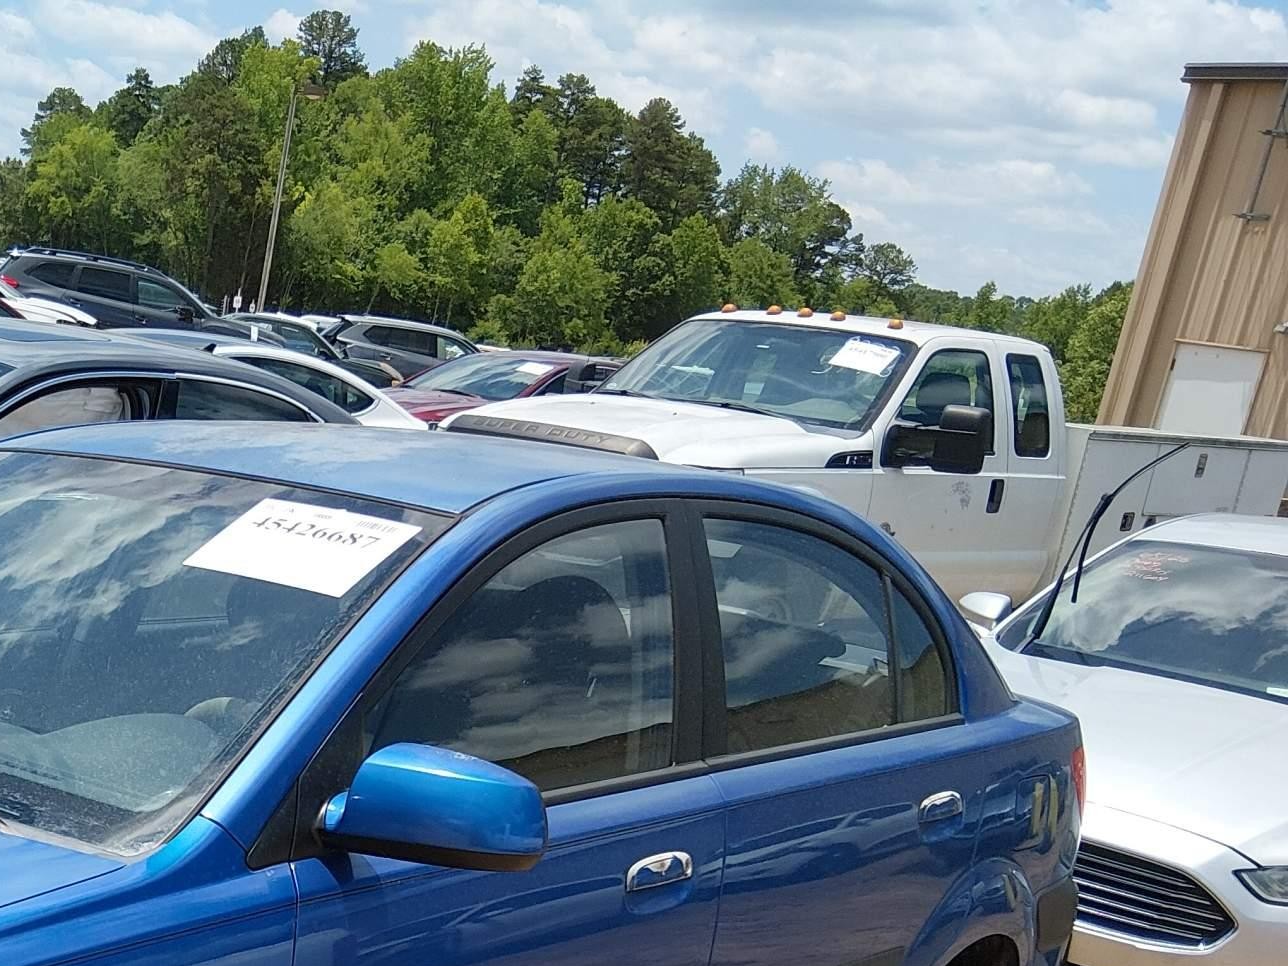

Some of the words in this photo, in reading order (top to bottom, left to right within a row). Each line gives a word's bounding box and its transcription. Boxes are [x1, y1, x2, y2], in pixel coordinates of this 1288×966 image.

[472, 416, 538, 434] SUPER
[543, 426, 610, 444] DUTY
[252, 516, 381, 549] 45426687
